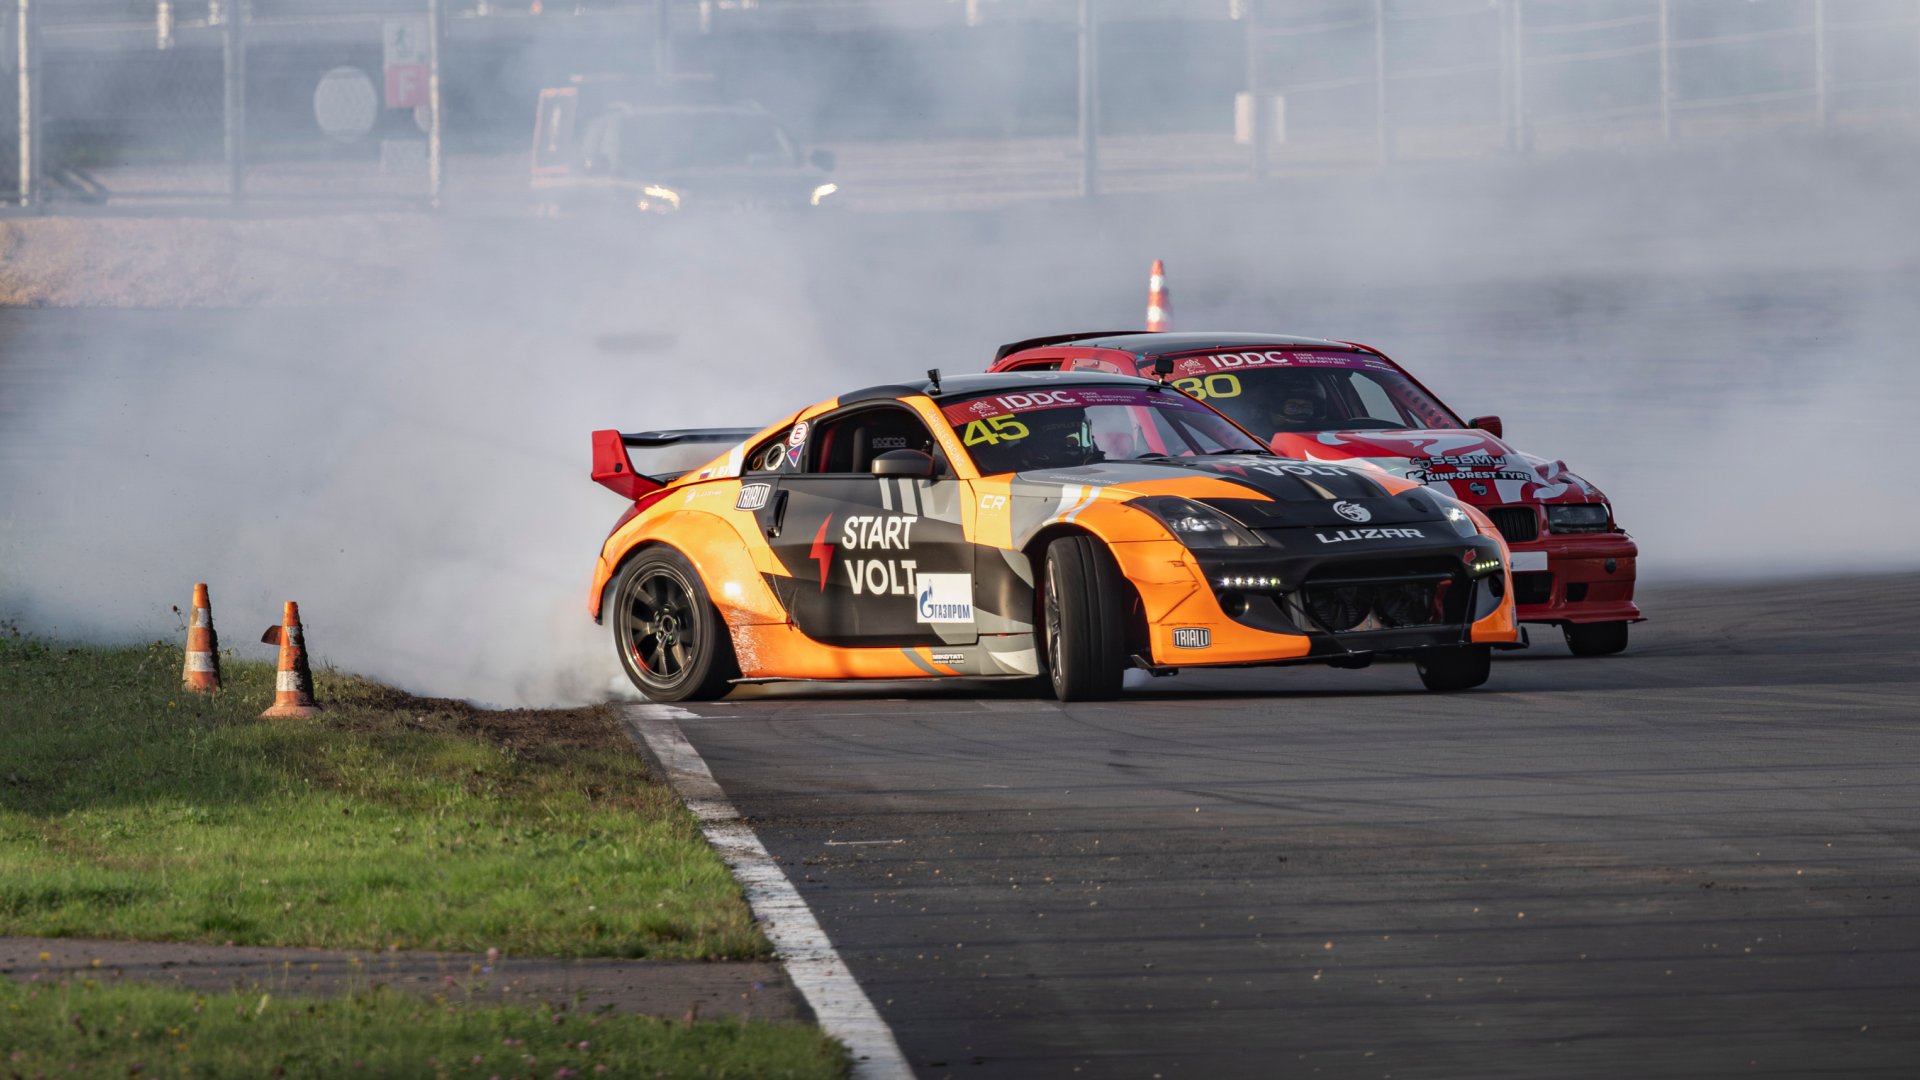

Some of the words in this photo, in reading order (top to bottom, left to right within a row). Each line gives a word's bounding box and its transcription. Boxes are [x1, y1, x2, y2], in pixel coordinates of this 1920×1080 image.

[398, 68, 418, 103] F
[1208, 351, 1288, 368] IDDC
[1171, 373, 1242, 401] 30
[995, 390, 1076, 410] IDDC
[926, 408, 947, 441] CARVILLE
[944, 439, 965, 467] RACING
[963, 413, 1030, 447] 45
[1429, 455, 1506, 465] SSBMW
[1252, 465, 1349, 477] VOLT
[1426, 471, 1497, 481] KINFOREST
[1499, 471, 1531, 482] TYRE
[736, 485, 770, 509] TRIALLI
[980, 494, 1006, 511] CR
[841, 515, 918, 550] START
[1314, 528, 1426, 544] LUZAR
[843, 559, 918, 595] VOLT
[934, 603, 971, 619] ГАЗПРОМ
[1174, 629, 1209, 647] TRIALLI
